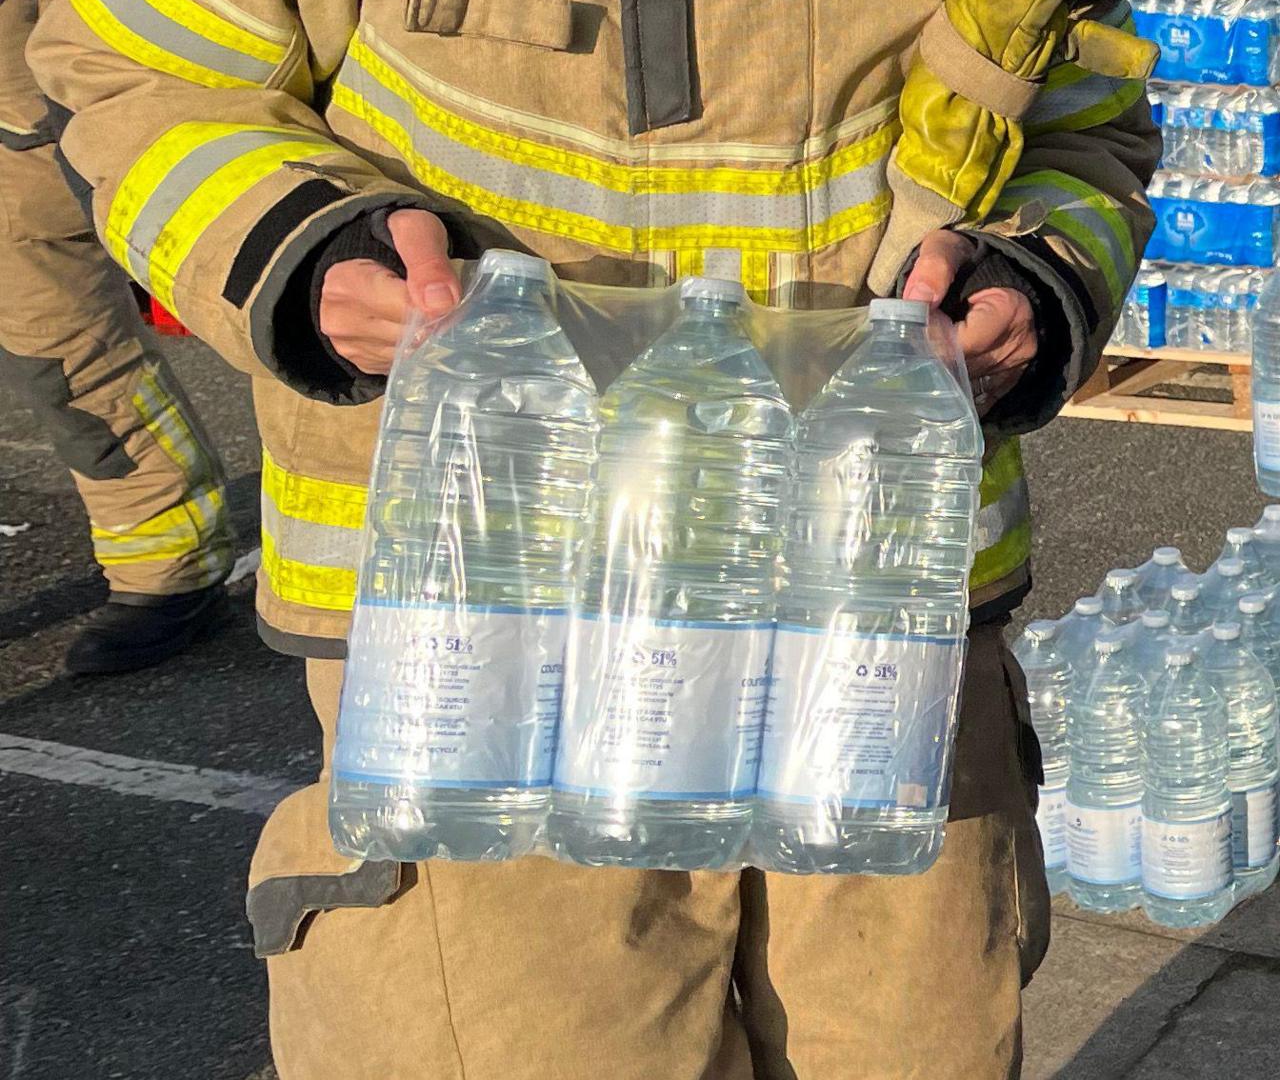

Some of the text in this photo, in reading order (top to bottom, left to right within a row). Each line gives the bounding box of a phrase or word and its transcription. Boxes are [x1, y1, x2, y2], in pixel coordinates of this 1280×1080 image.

[445, 636, 473, 653] 51%
[651, 650, 677, 666] 51%
[874, 664, 898, 680] 51%
